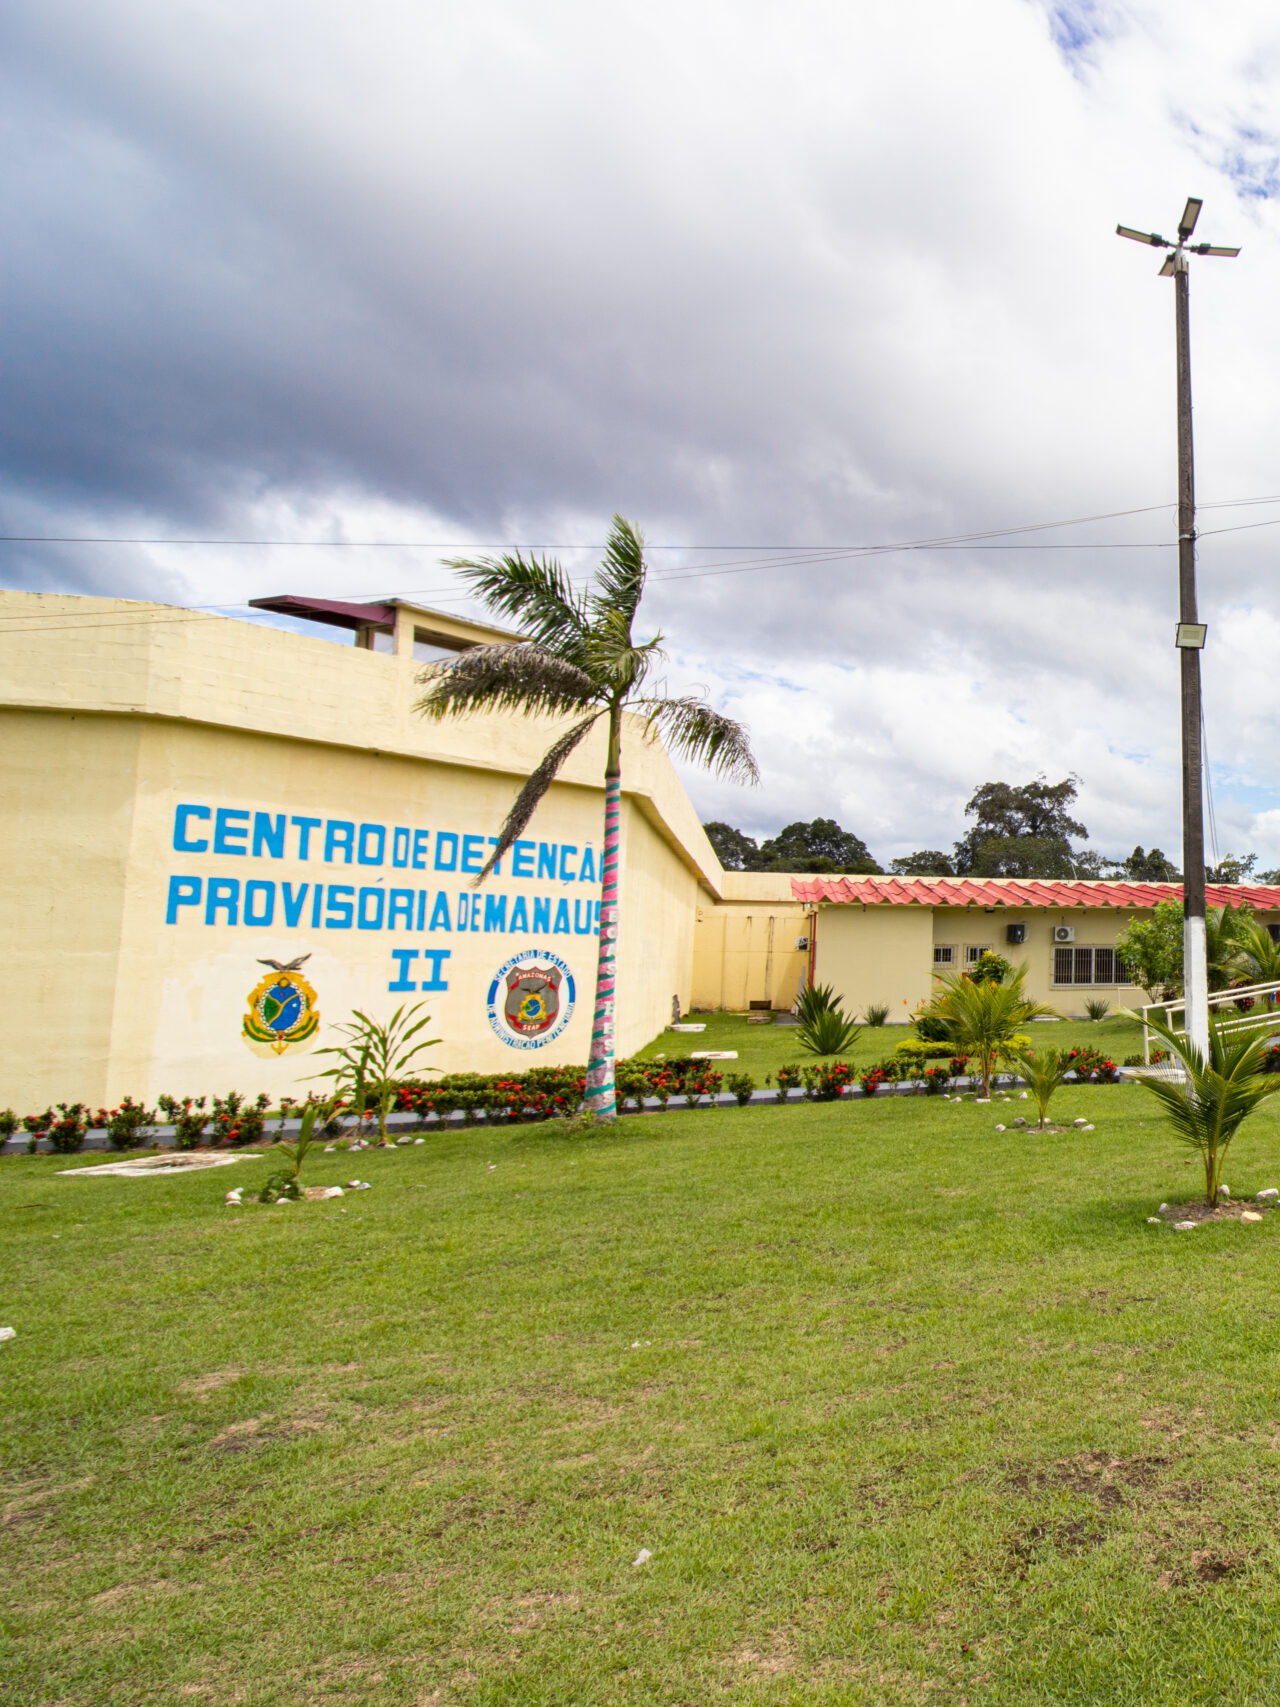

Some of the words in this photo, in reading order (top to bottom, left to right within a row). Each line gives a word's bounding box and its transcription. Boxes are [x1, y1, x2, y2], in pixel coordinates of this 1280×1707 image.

[172, 804, 387, 866] CENTRO
[392, 826, 429, 870] DE
[434, 831, 604, 886] DETENÇÃ
[166, 875, 452, 932] PROVISÓRIA
[457, 892, 481, 932] DE
[388, 949, 451, 992] II
[518, 972, 552, 982] AMAZONAS
